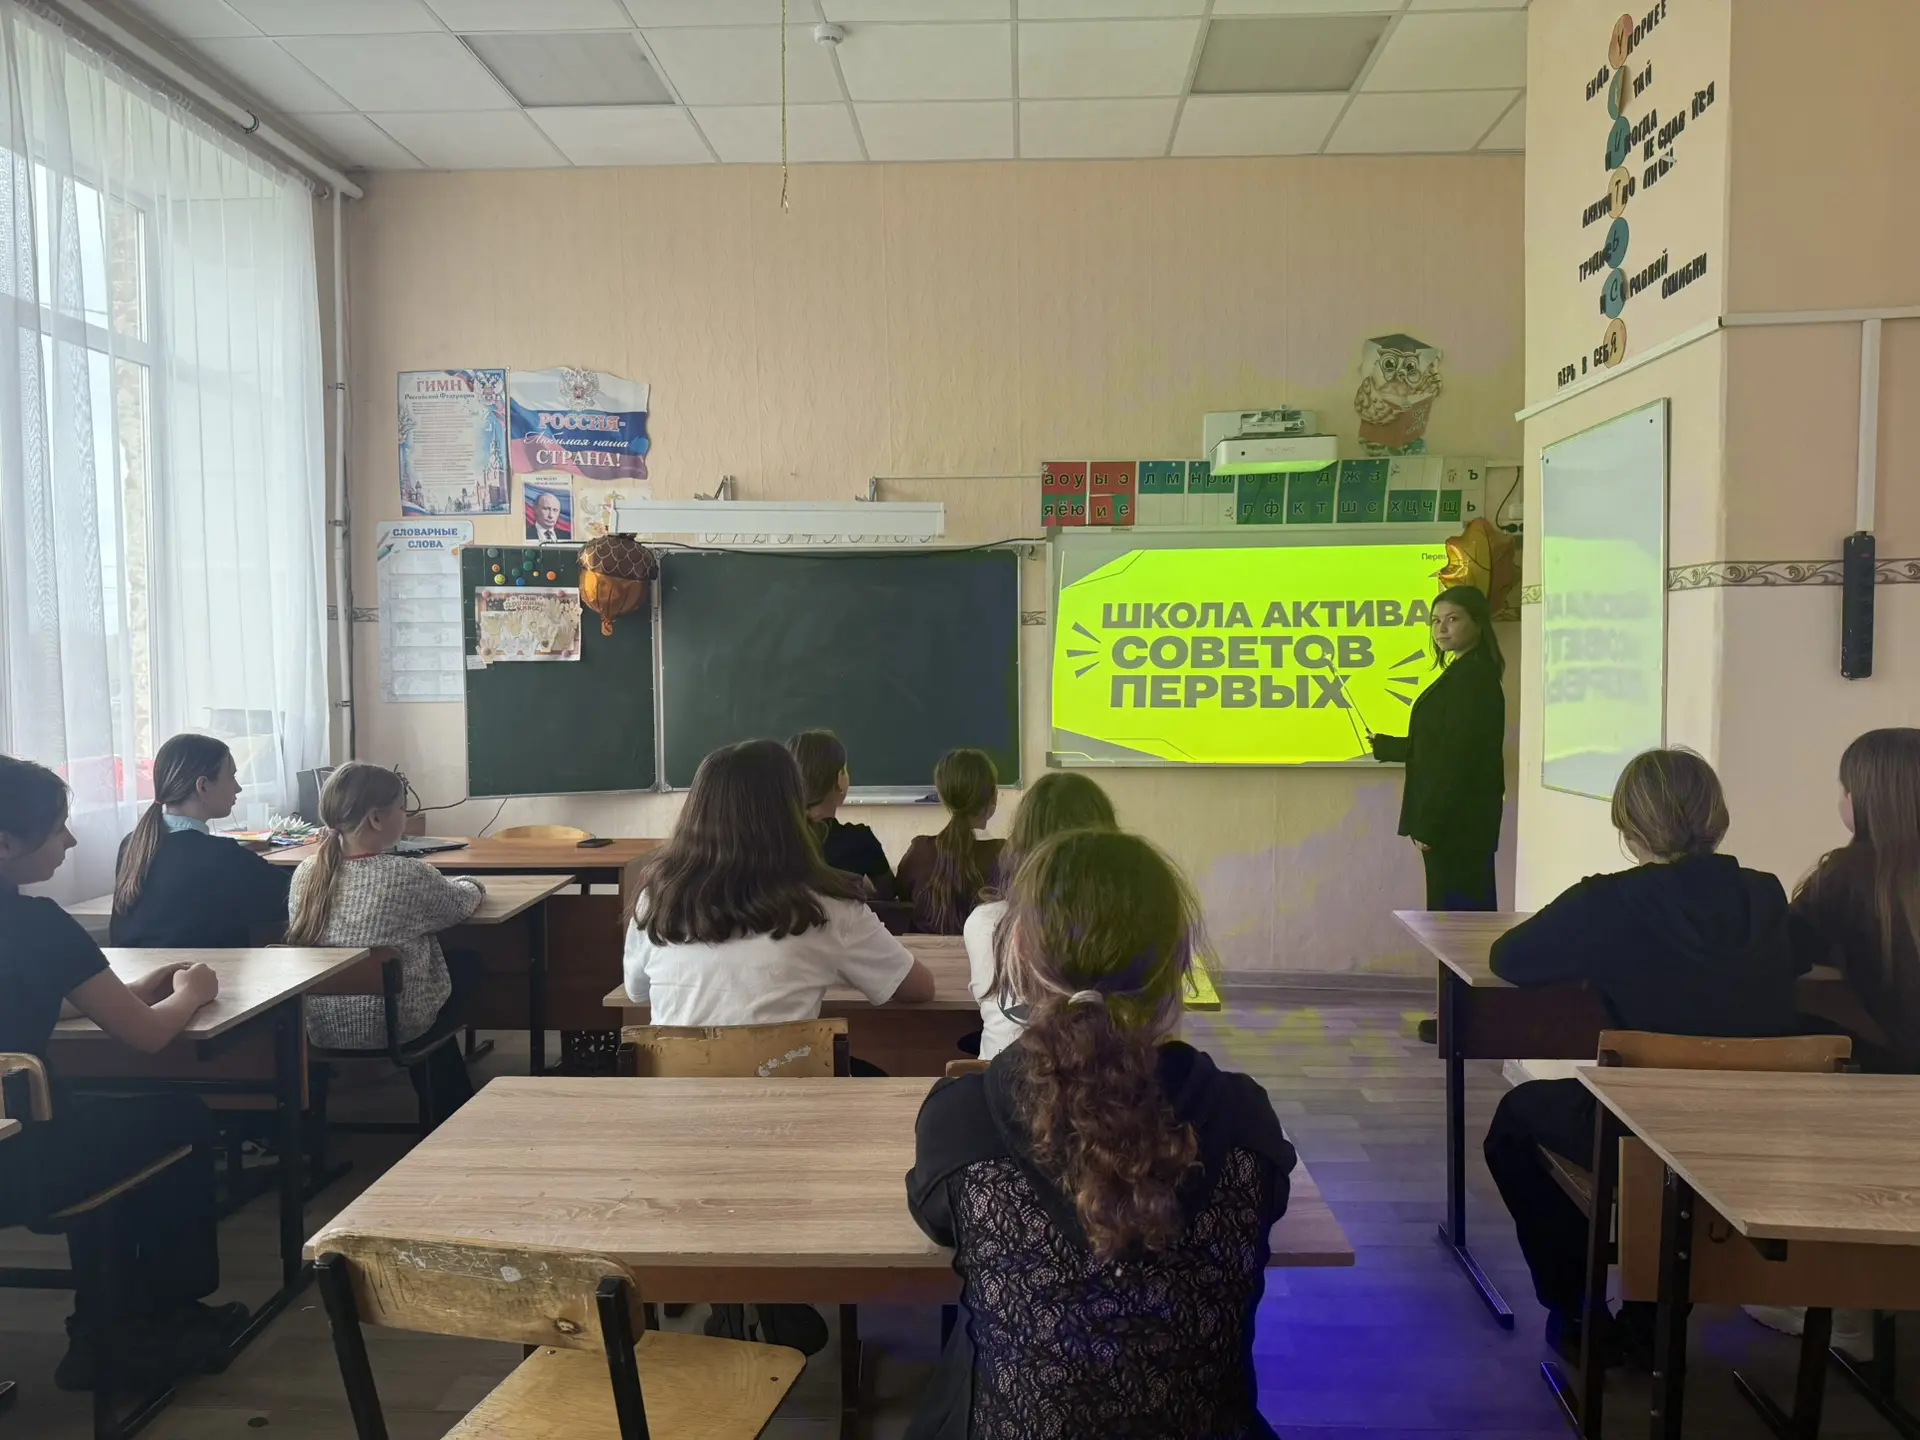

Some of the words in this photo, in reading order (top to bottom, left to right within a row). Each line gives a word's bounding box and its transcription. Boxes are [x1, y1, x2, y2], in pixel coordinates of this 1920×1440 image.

[1586, 64, 1609, 101] БУДЬ
[1643, 136, 1655, 162] НЕ
[1661, 252, 1707, 300] ОШИБКИ
[417, 380, 462, 393] ГИМН
[1557, 363, 1576, 389] ВЕРЬ
[1582, 356, 1587, 375] В
[536, 449, 621, 467] СТРАНА!
[392, 528, 458, 536] СЛОВАРНЫЕ
[408, 540, 443, 548] СЛОВА
[1102, 602, 1253, 629] ШКОЛА
[1261, 600, 1431, 628] АКТИВА
[1111, 635, 1375, 669] СОВЕТОВ
[1110, 675, 1353, 708] ПЕРВЫХ
